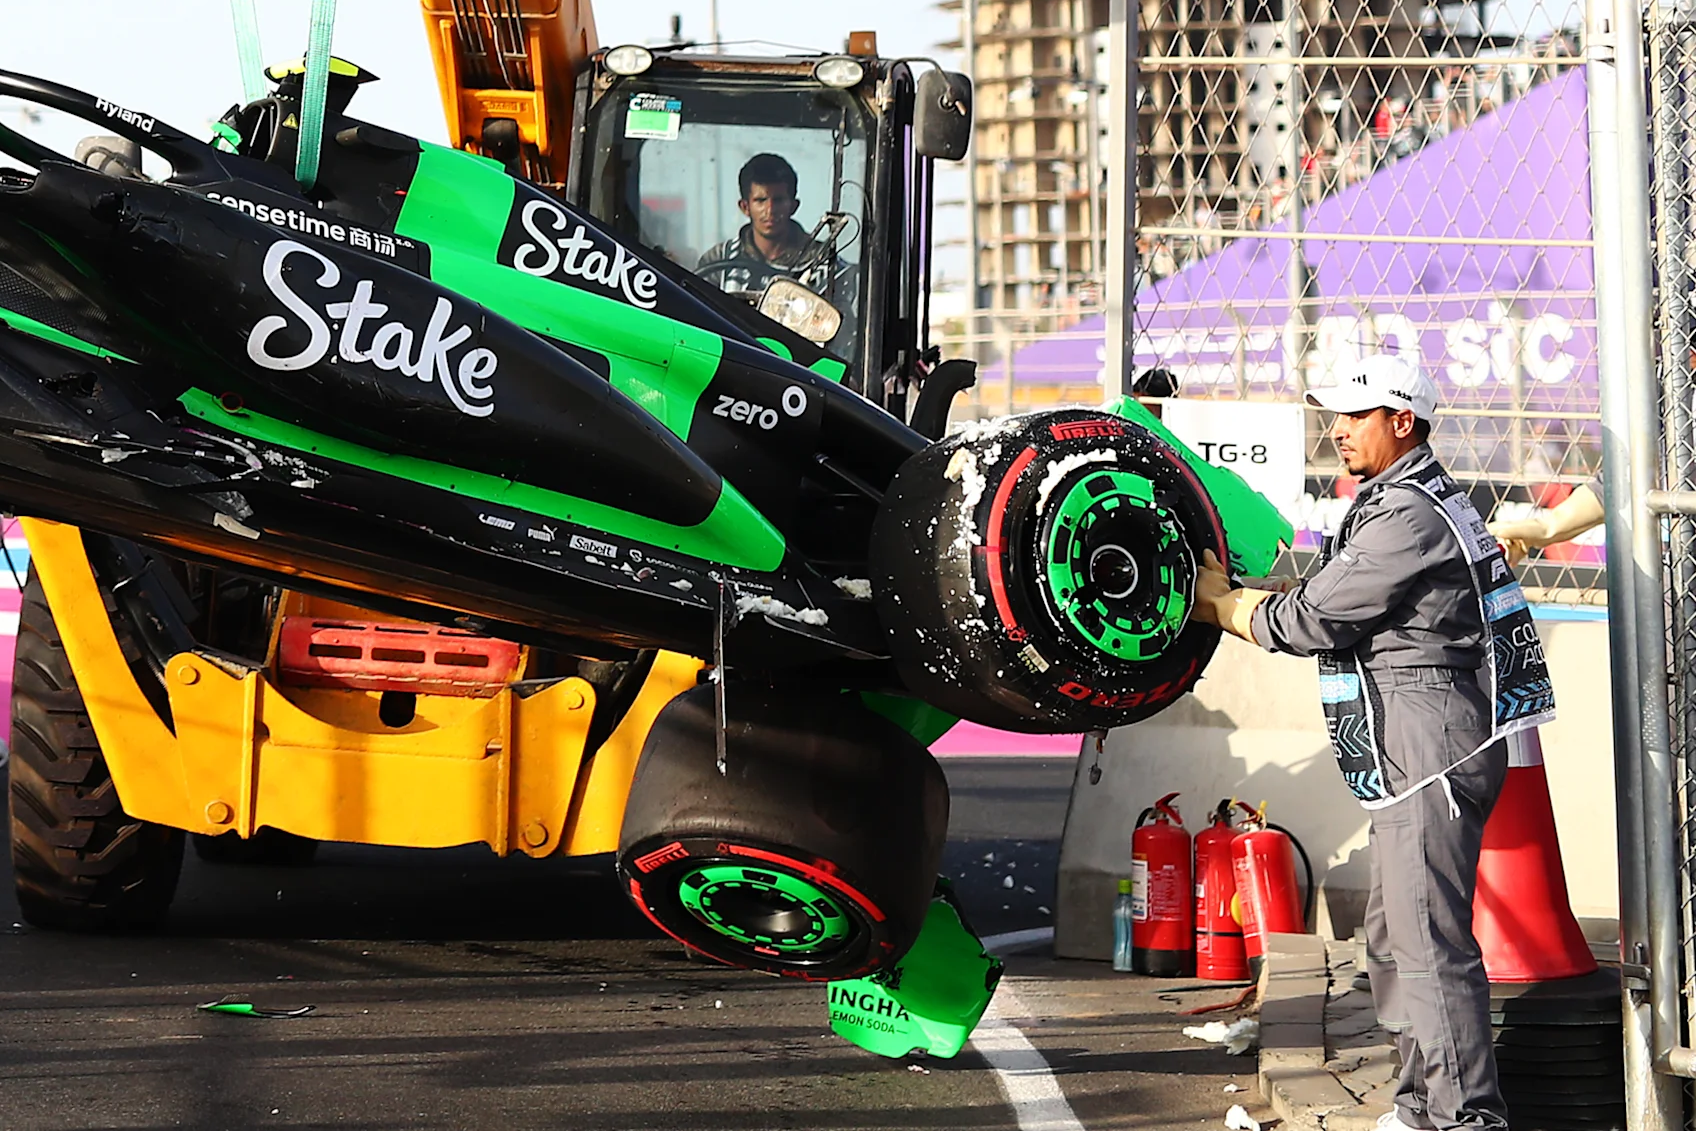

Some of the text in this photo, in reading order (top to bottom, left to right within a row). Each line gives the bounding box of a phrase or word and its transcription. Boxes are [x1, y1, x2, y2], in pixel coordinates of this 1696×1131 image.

[95, 97, 155, 133] Hyland
[513, 199, 658, 309] Stake
[247, 239, 498, 417] Stake
[712, 394, 779, 430] zero
[1388, 389, 1412, 402] adidas
[1050, 419, 1125, 441] PIRELLI
[1198, 441, 1268, 464] TG-8
[634, 841, 690, 874] PIRELLI
[830, 986, 910, 1022] INGHA
[829, 1010, 896, 1035] EMON SODA
